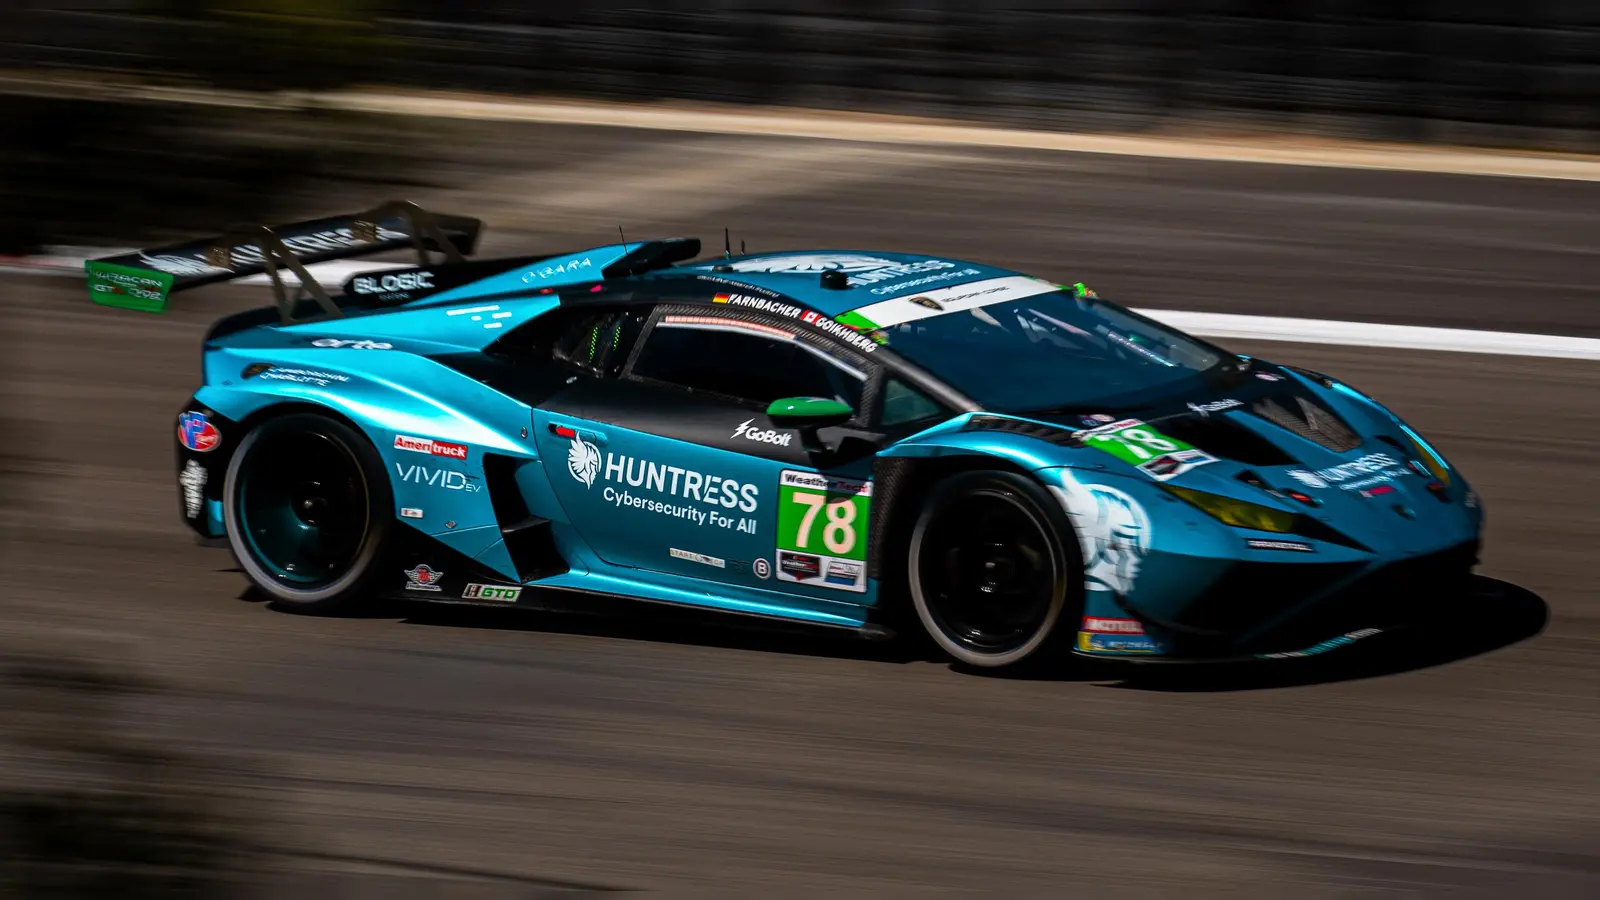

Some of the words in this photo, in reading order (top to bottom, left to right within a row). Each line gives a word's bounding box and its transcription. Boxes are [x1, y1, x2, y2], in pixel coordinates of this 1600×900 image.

[728, 293, 802, 319] FARNBACHER
[815, 319, 878, 353] GOIKHBERG
[396, 437, 466, 457] Ameritruck
[745, 427, 793, 447] GoBolt
[1094, 428, 1178, 459] 78
[396, 462, 466, 489] VIVID
[604, 452, 760, 513] HUNTRESS
[603, 486, 707, 526] Cybersecurity
[709, 511, 735, 529] For
[736, 519, 758, 535] All
[792, 491, 857, 554] 78
